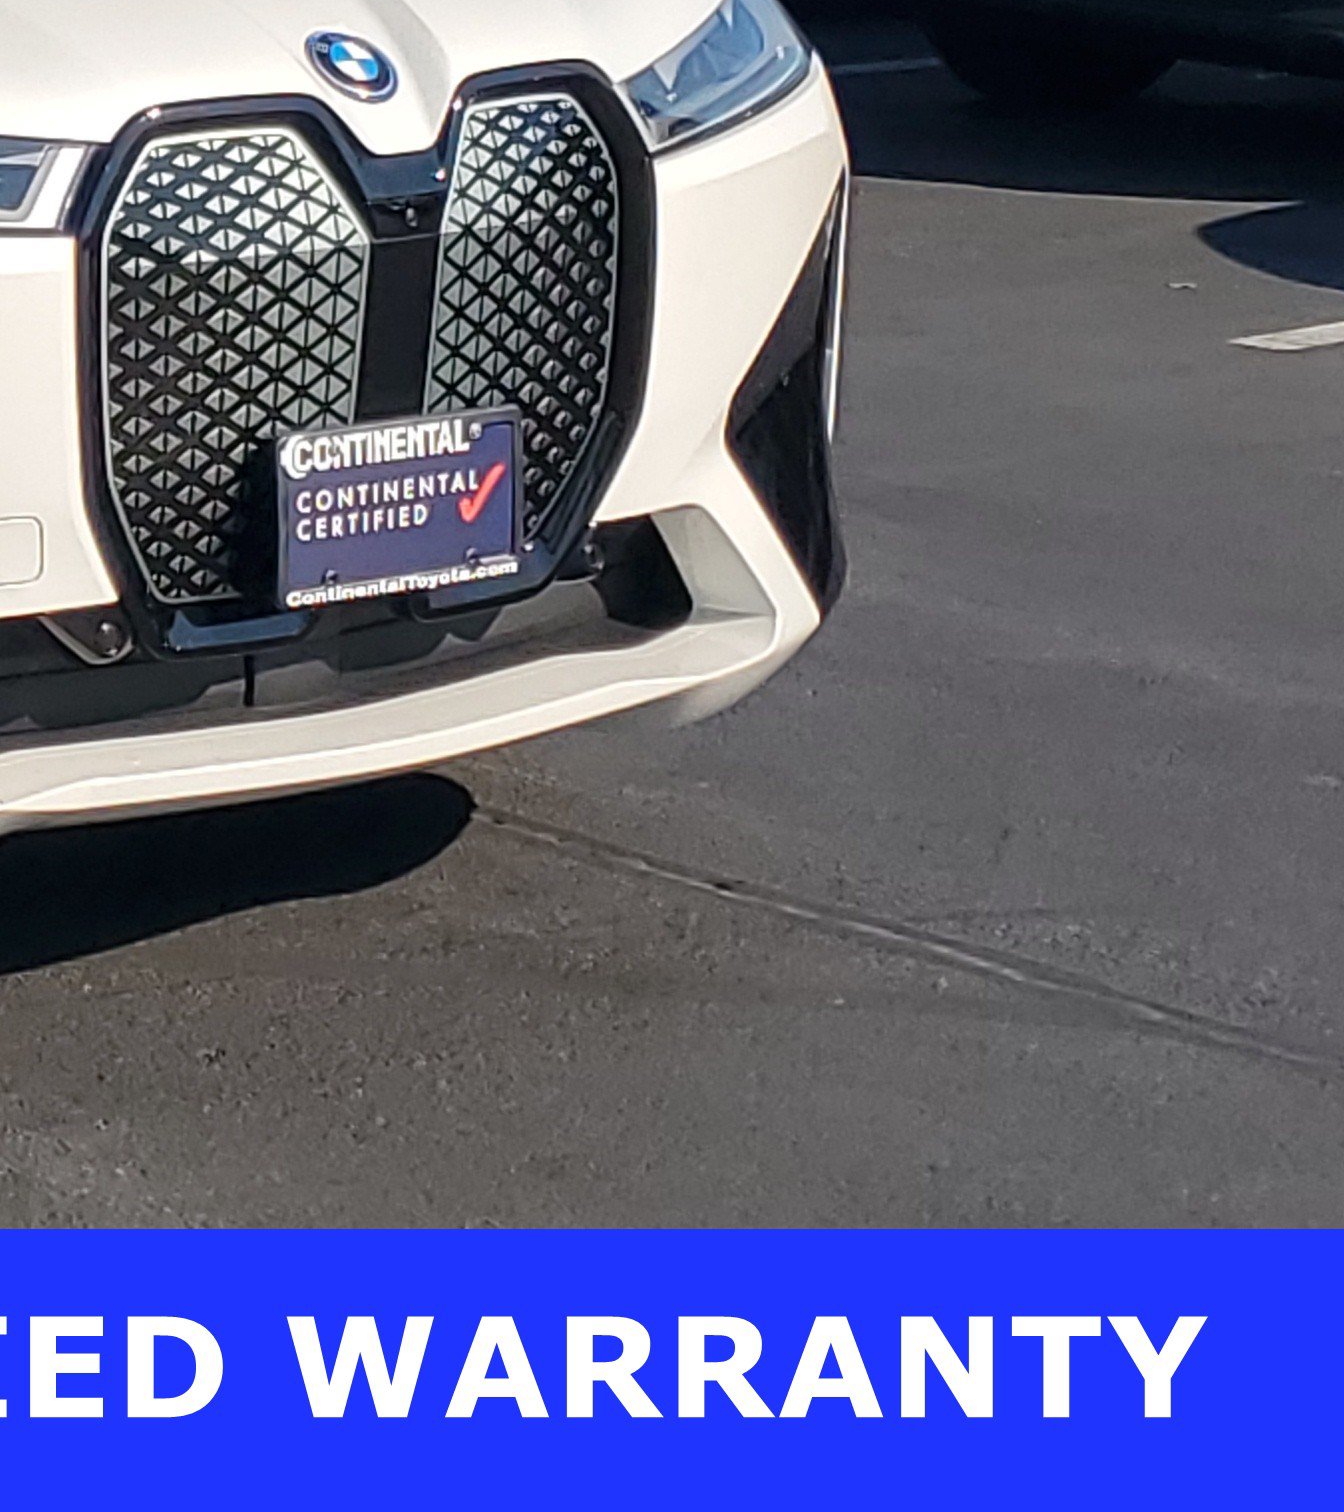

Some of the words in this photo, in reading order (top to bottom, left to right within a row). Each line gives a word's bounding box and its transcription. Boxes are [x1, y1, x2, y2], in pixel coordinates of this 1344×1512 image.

[280, 419, 471, 479] CONTINENTAL
[296, 470, 480, 514] CONTINENTAL
[296, 504, 429, 542] CERTIFIED
[285, 561, 519, 608] ContinentalToyota.com
